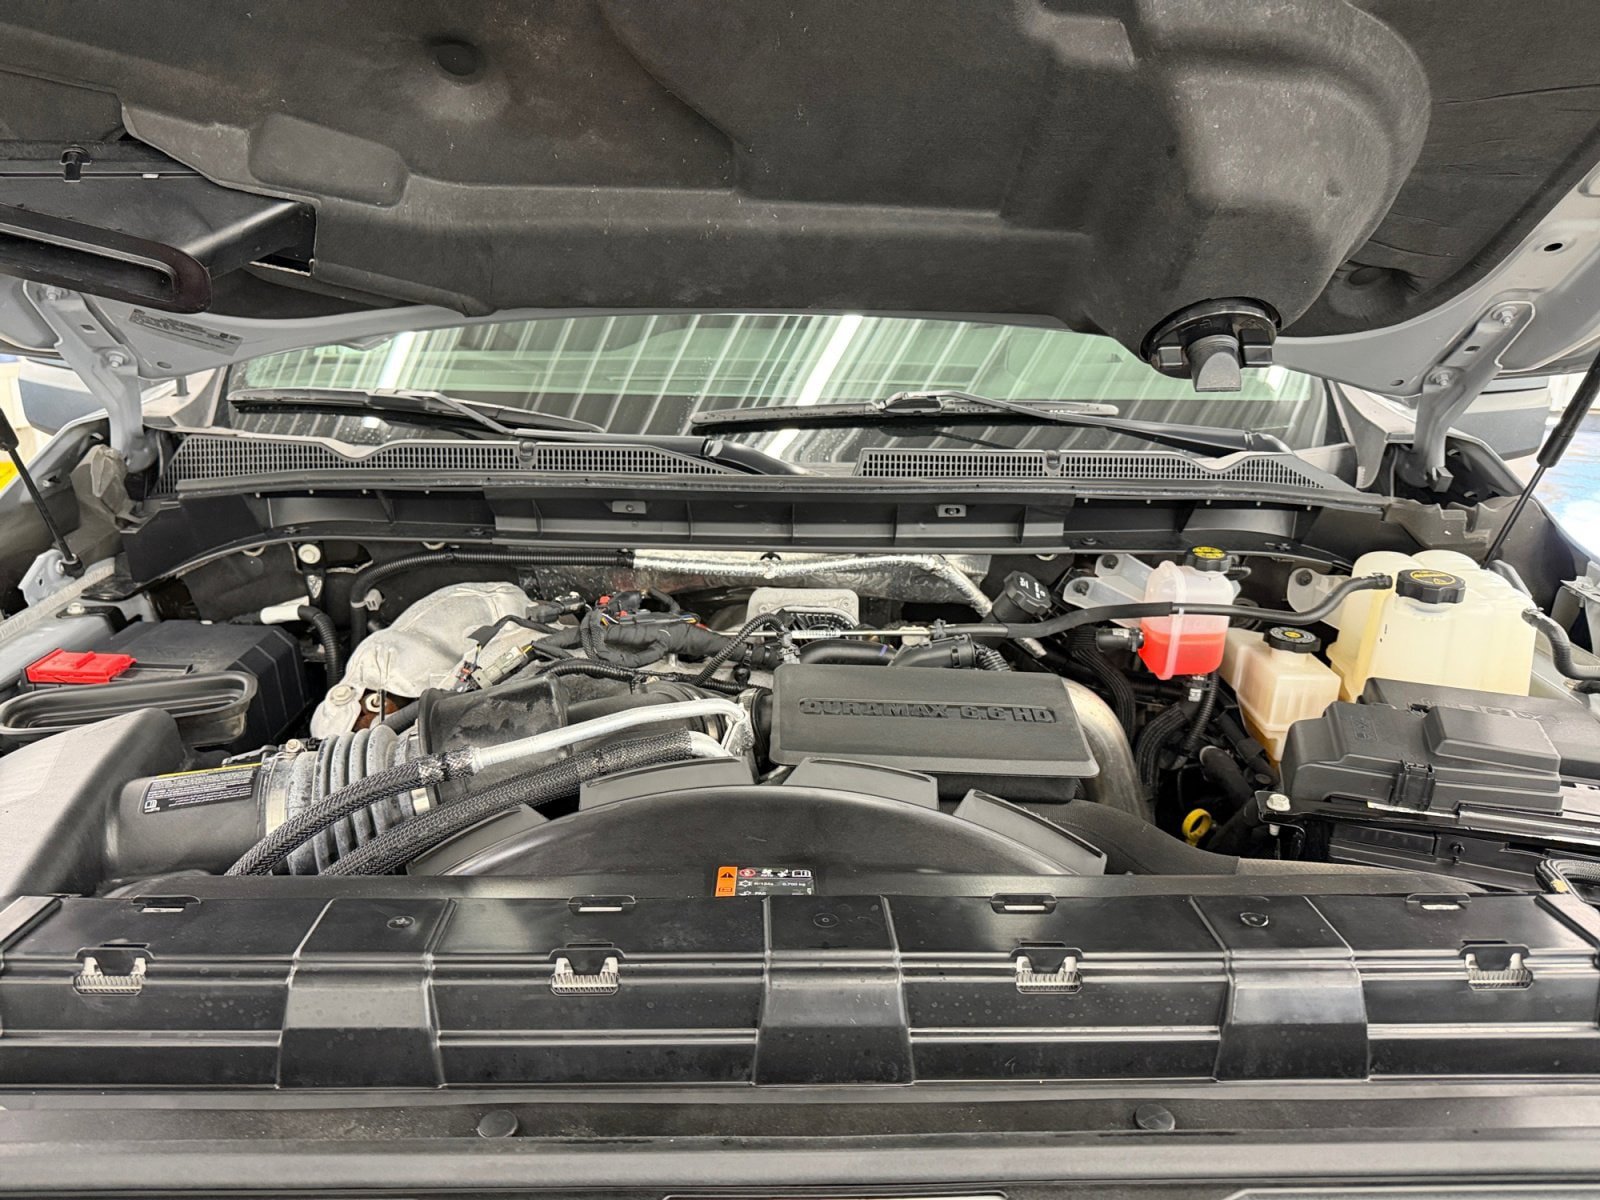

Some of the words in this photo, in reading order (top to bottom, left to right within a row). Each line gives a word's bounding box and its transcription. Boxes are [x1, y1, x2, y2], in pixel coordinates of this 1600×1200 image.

[799, 700, 949, 719] DURAMAX
[960, 704, 1006, 721] 6.6
[1011, 706, 1057, 723] HD
